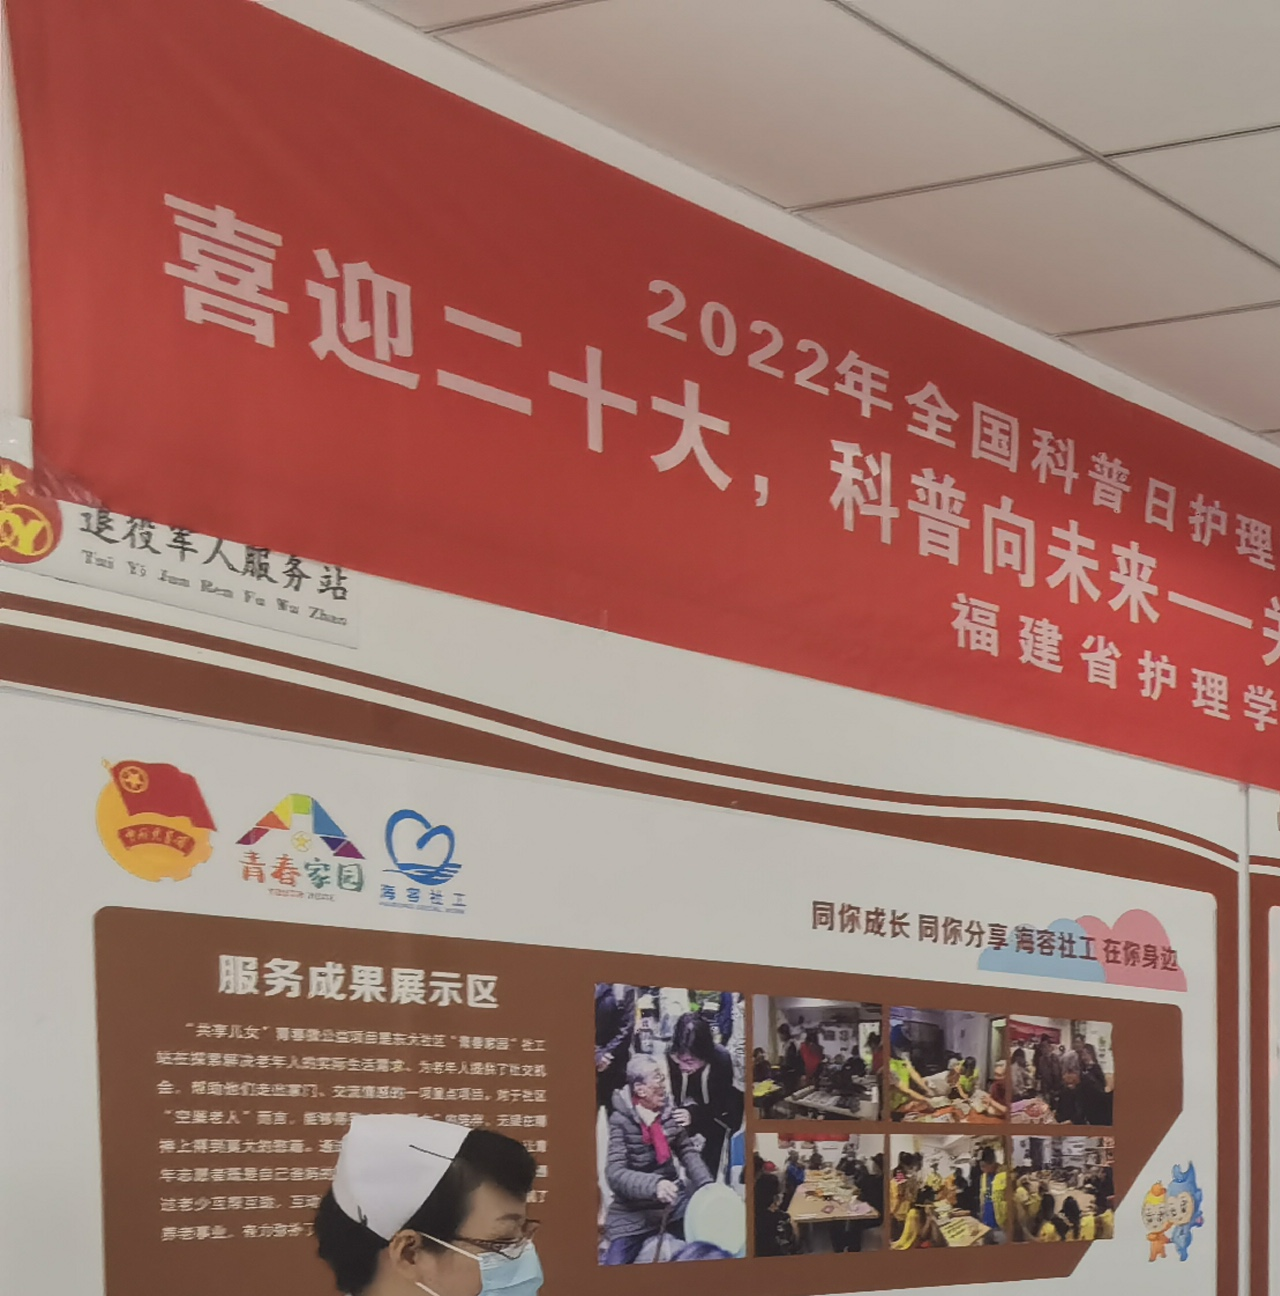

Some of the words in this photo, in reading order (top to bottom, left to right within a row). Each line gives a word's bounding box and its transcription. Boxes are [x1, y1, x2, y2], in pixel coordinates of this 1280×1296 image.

[80, 508, 348, 600] 退役军人服务站
[239, 850, 364, 892] 青春家园
[812, 900, 911, 939] 同你成长
[918, 913, 1008, 951] 同你分享
[1014, 924, 1097, 962] 海容社工
[1104, 937, 1178, 972] 在你身边
[218, 954, 499, 1009] 服务成果展示区
